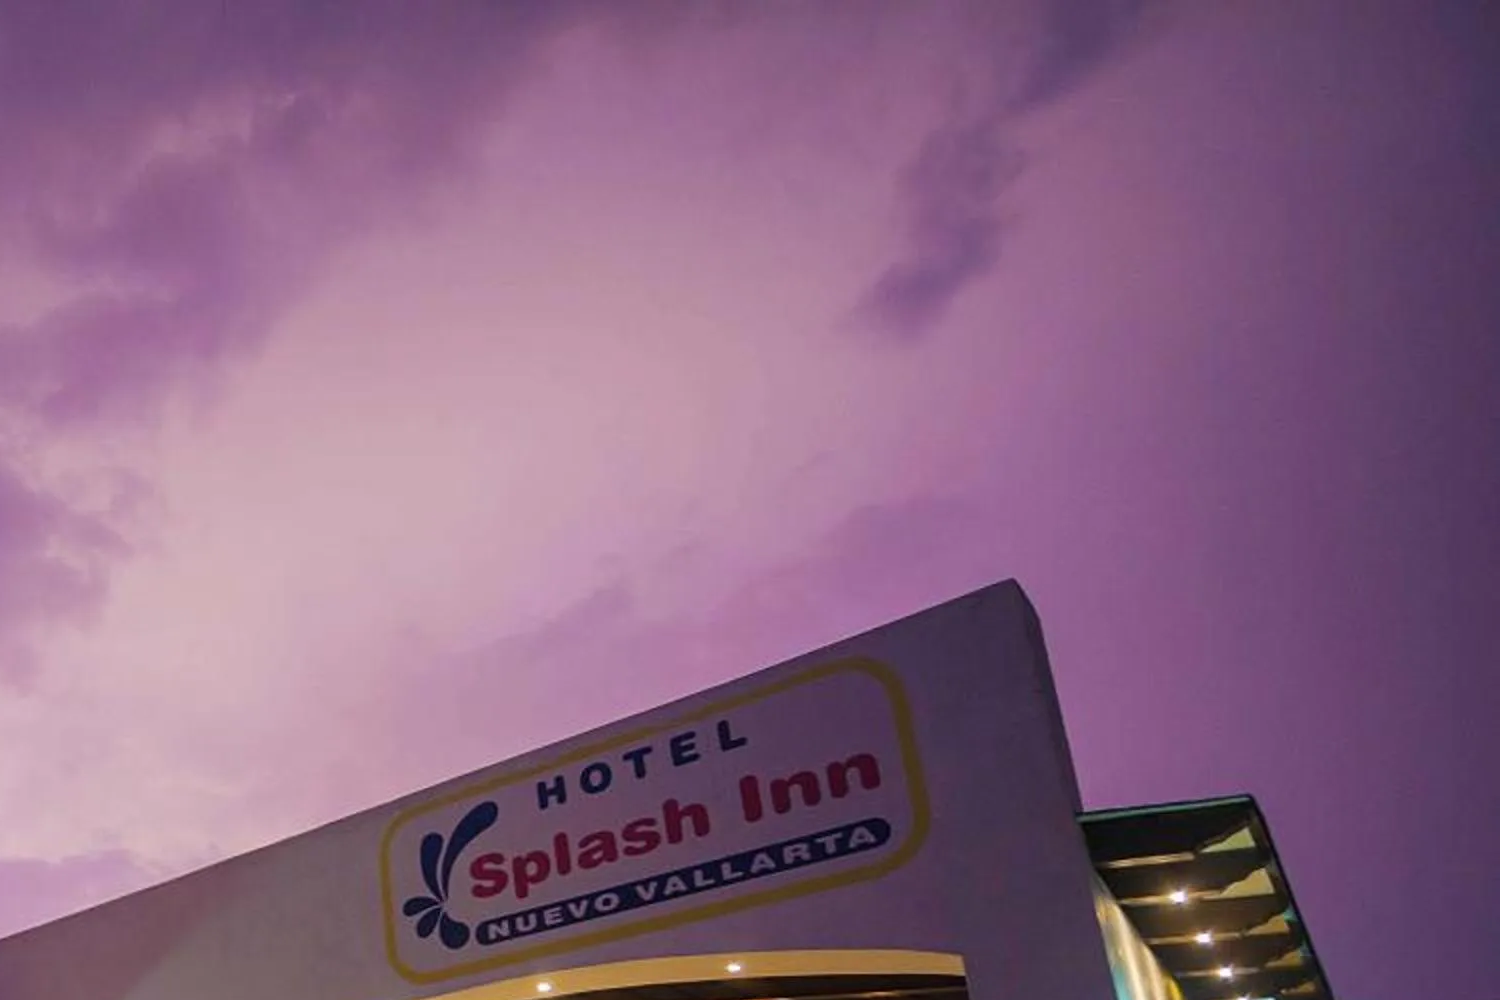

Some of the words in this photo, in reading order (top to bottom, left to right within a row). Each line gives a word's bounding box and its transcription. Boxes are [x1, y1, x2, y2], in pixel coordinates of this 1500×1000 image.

[536, 719, 748, 810] HOTEL
[469, 798, 711, 899] Splash
[738, 753, 881, 823] Inn
[487, 892, 620, 941] NUEVO
[632, 825, 877, 902] VALLARTA
